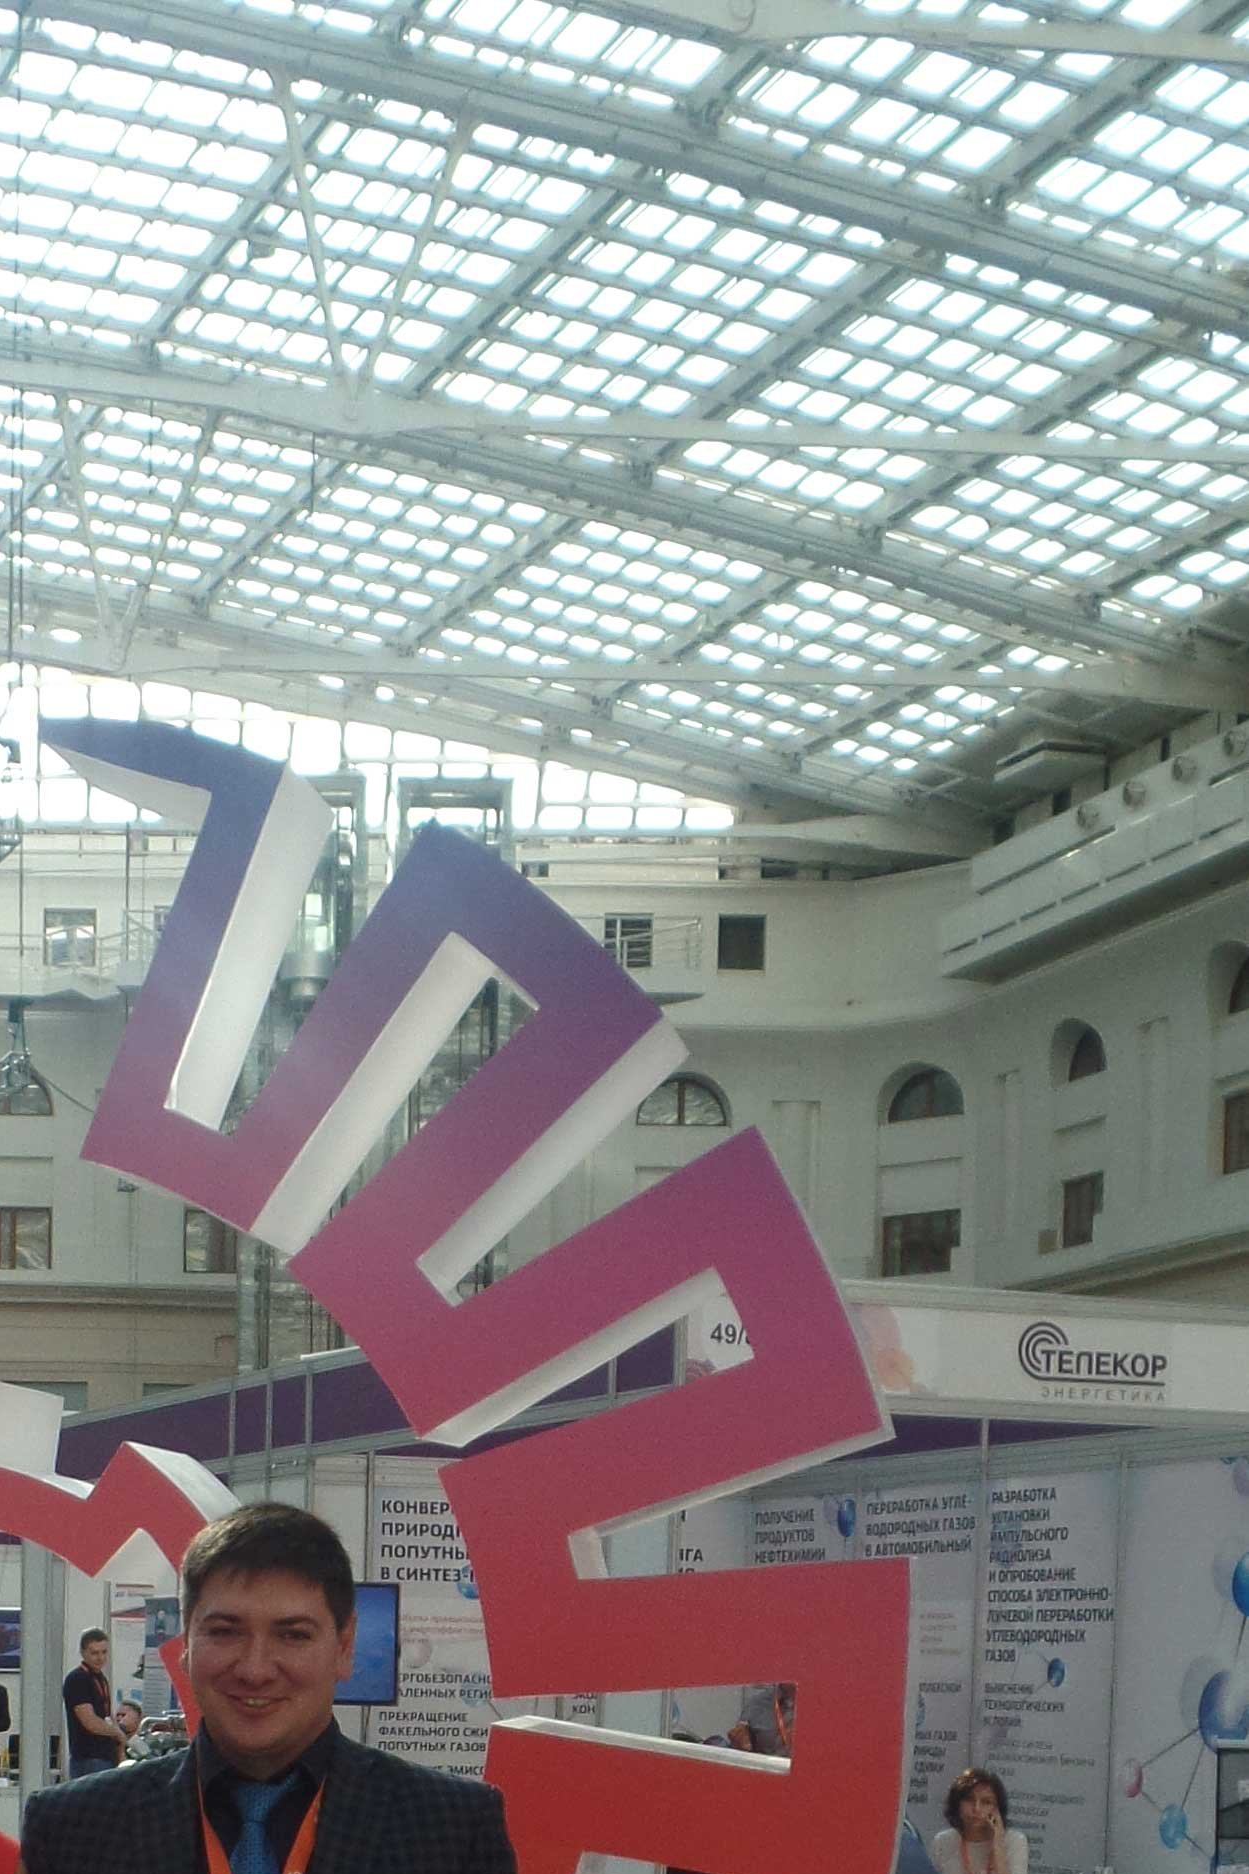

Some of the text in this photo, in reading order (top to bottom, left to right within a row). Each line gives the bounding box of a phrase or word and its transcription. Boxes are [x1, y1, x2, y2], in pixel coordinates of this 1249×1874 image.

[1041, 1349, 1168, 1378] ТЕЛЕКОР
[1040, 1386, 1166, 1401] ЭНЕРГЕТИКА
[991, 1488, 1057, 1504] РАЗРАБОТКА
[381, 1500, 454, 1515] КОНВЕР
[866, 1498, 939, 1515] ПЕРЕРАБОТКА
[755, 1508, 815, 1525] ПОЛУЧЕНИЕ
[991, 1509, 1050, 1523] УСТАНОВКИ
[866, 1516, 976, 1538] ВОДОРОДНЫХ ГАЗОВ
[755, 1528, 815, 1544] ПРОДУКТОВ
[990, 1527, 1069, 1543] ИМПУЛЬСНОГО
[380, 1544, 470, 1560] ПОПУТНЫ
[875, 1535, 972, 1556] АВТОМОБИЛЬНЫЙ
[754, 1549, 826, 1564] НЕФТЕХИМИИ
[989, 1549, 1052, 1564] РАДИОЛИЗА
[380, 1566, 390, 1580] В
[989, 1568, 1077, 1583] И ОПРОБОВАНИЕ
[987, 1587, 1112, 1603] СПОСОБА ЭЛЕКТРОННО-
[987, 1606, 1115, 1622] ЛУЧЕВОЙ ПЕРЕРАБОТКИ
[986, 1629, 1087, 1644] УГЛЕВОДОРОДНЫХ
[985, 1649, 1016, 1662] ГАЗОВ
[572, 1704, 596, 1714] КОН
[378, 1711, 468, 1724] ПРЕКРАЩЕНИЕ
[378, 1726, 488, 1738] ФАКЕЛЬНОГО СЖИ
[378, 1740, 486, 1753] ПОПУТНЫХ ГАЗОВ
